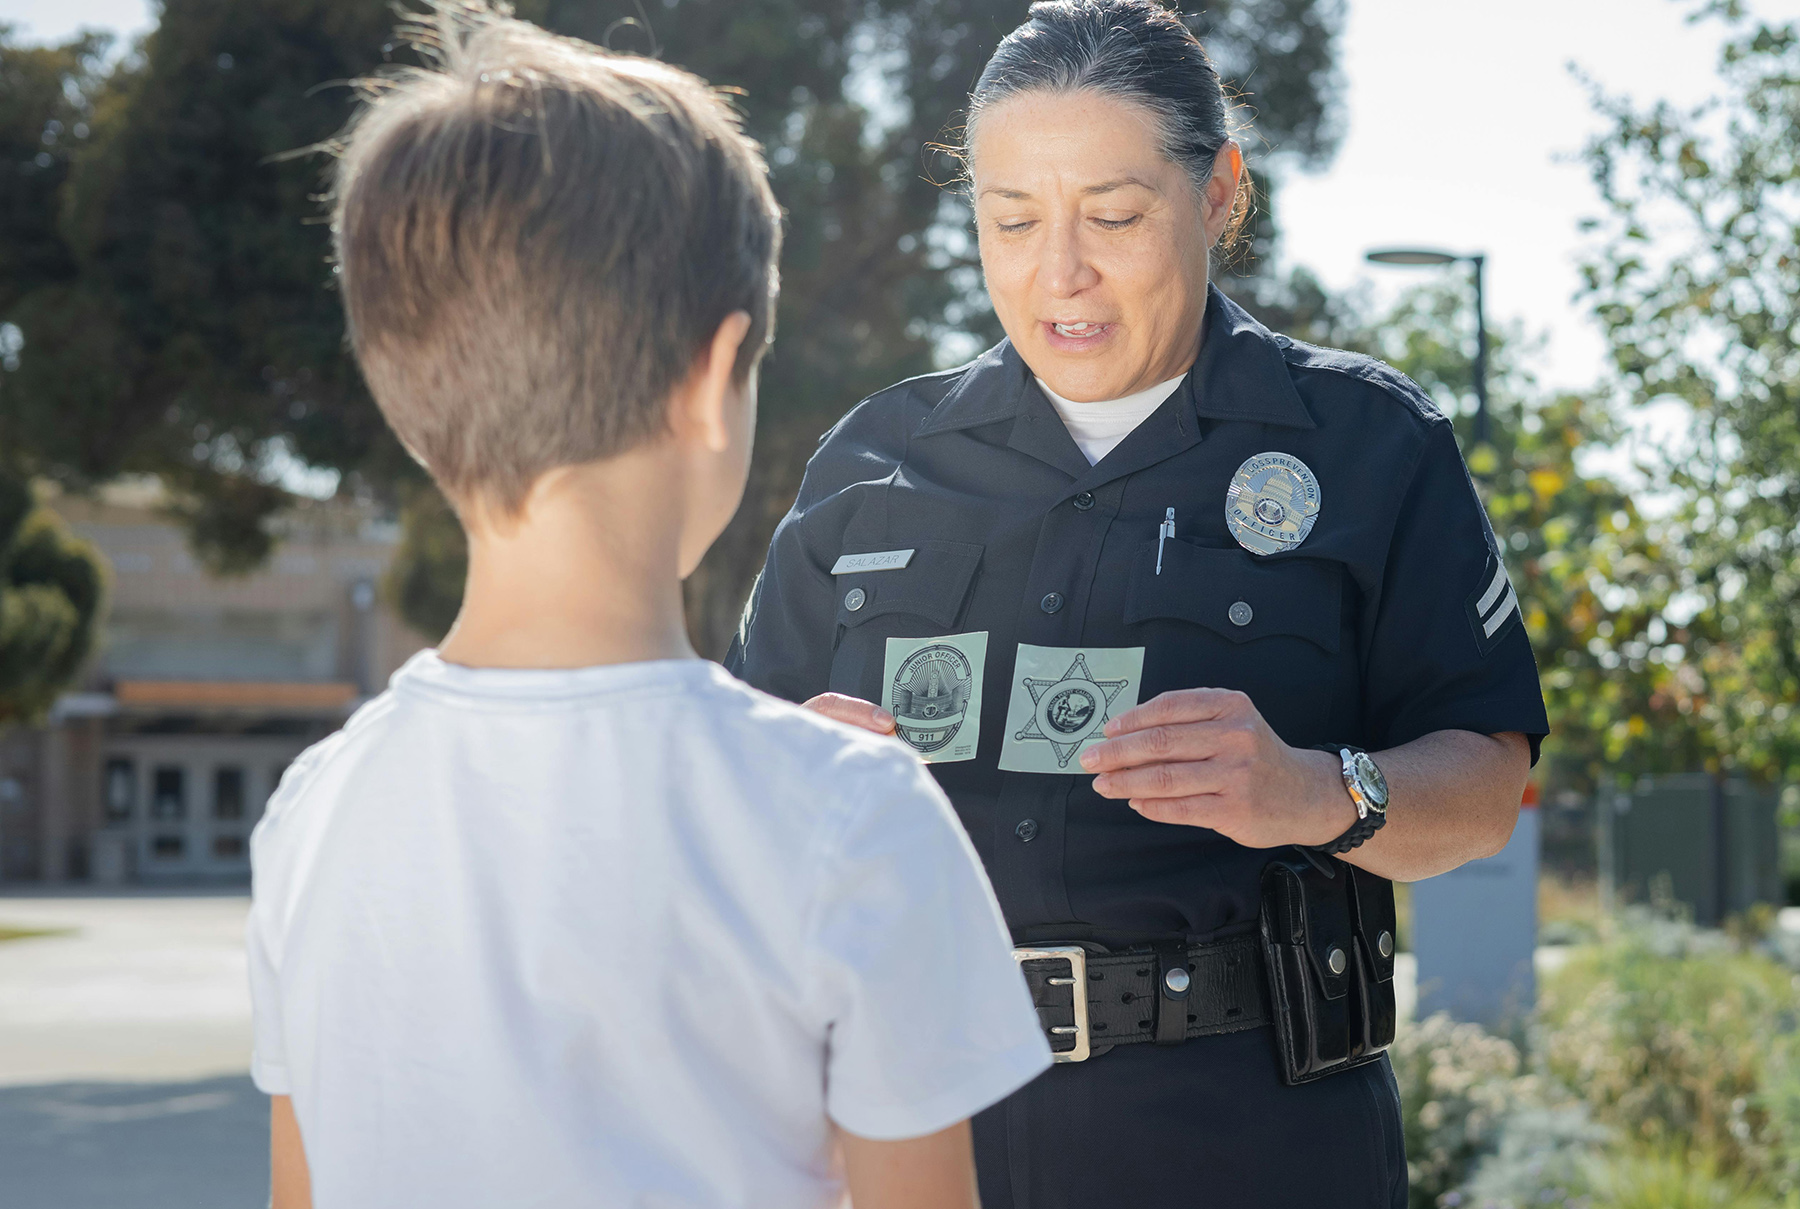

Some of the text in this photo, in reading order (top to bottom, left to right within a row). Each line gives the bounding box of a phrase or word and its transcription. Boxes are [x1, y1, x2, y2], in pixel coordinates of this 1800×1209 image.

[1233, 509, 1295, 541] OFFICER
[846, 554, 900, 569] SALAZAR
[908, 651, 961, 674] JUNIOR OFFICER
[918, 733, 935, 741] 911
